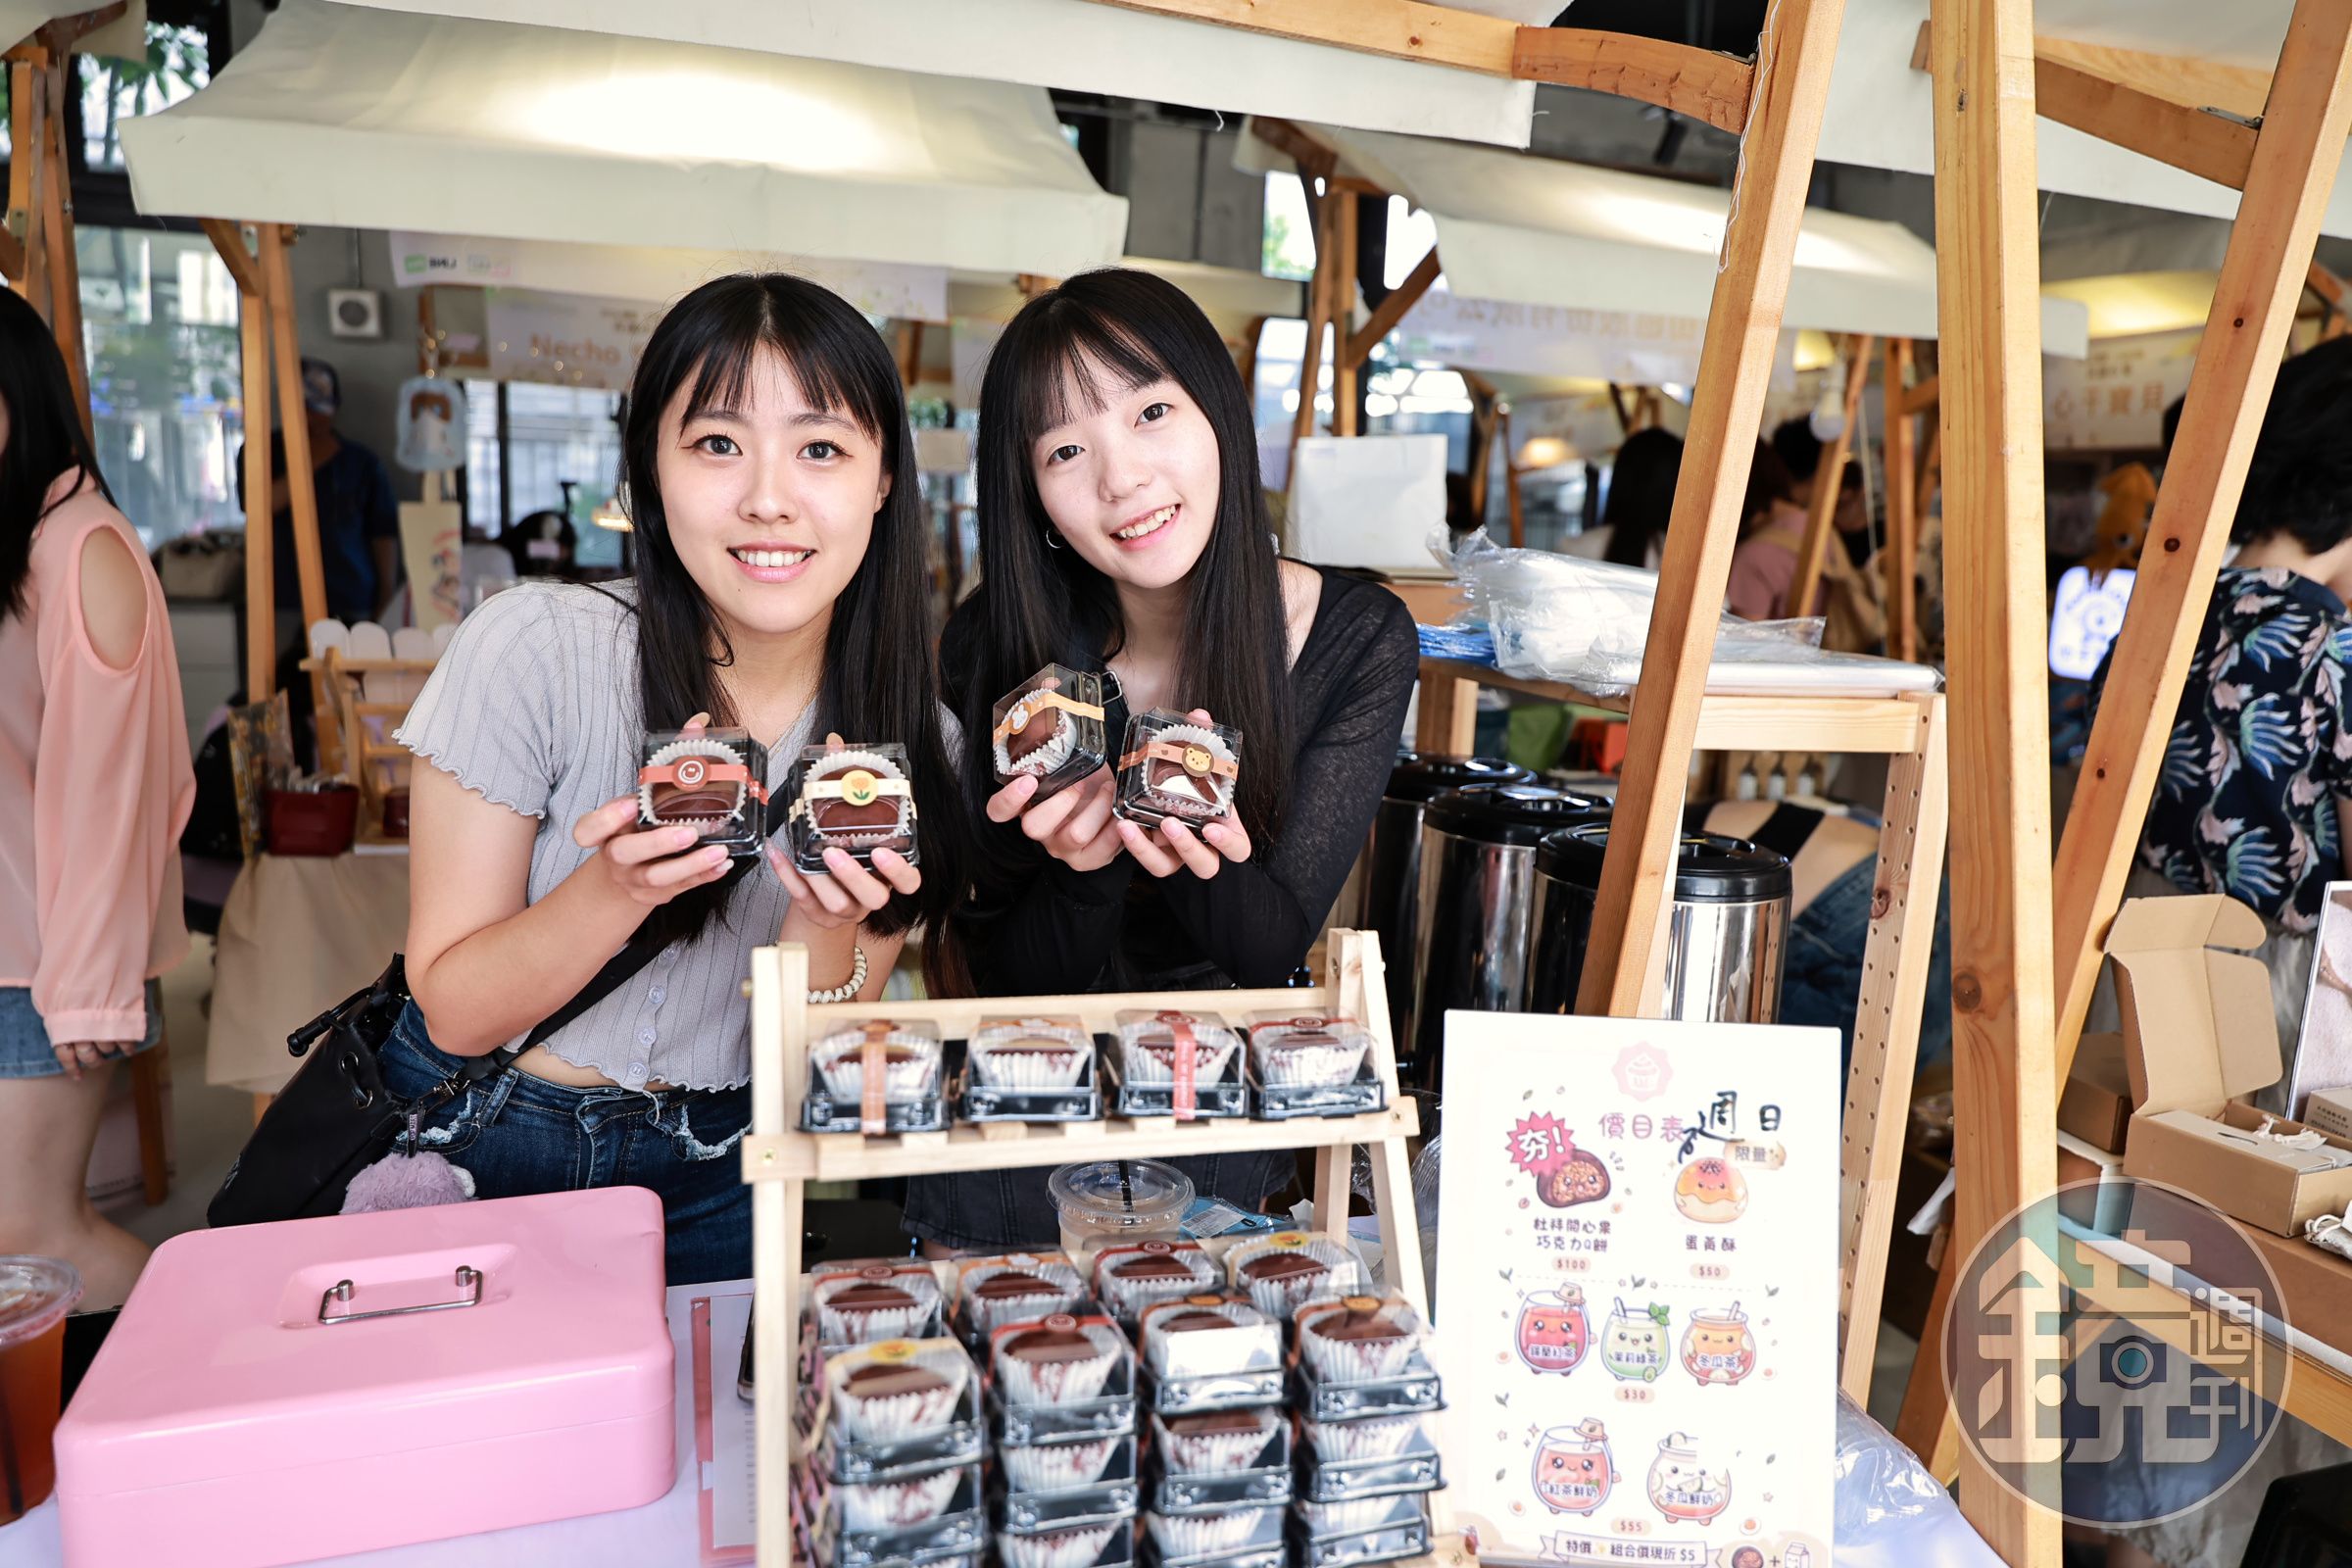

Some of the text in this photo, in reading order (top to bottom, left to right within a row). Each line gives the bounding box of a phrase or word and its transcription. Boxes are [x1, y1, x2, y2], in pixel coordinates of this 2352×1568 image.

[1598, 1112, 1688, 1144] 價目表
[1517, 1126, 1566, 1163] 夯!
[1735, 1145, 1767, 1163] 限量
[1686, 1235, 1737, 1251] 蛋黃酥
[1556, 1258, 1586, 1269] $100
[1698, 1265, 1721, 1277] $50
[1615, 1351, 1657, 1364] 茉莉綠茶
[1698, 1353, 1739, 1368] 冬瓜茶
[1624, 1389, 1646, 1400] $30
[1549, 1484, 1597, 1498] 紅茶鮮奶
[1666, 1491, 1714, 1505] 冬瓜鮮奶
[1620, 1520, 1642, 1532] $55
[1566, 1540, 1695, 1561] 特價 組合價現折 $5
